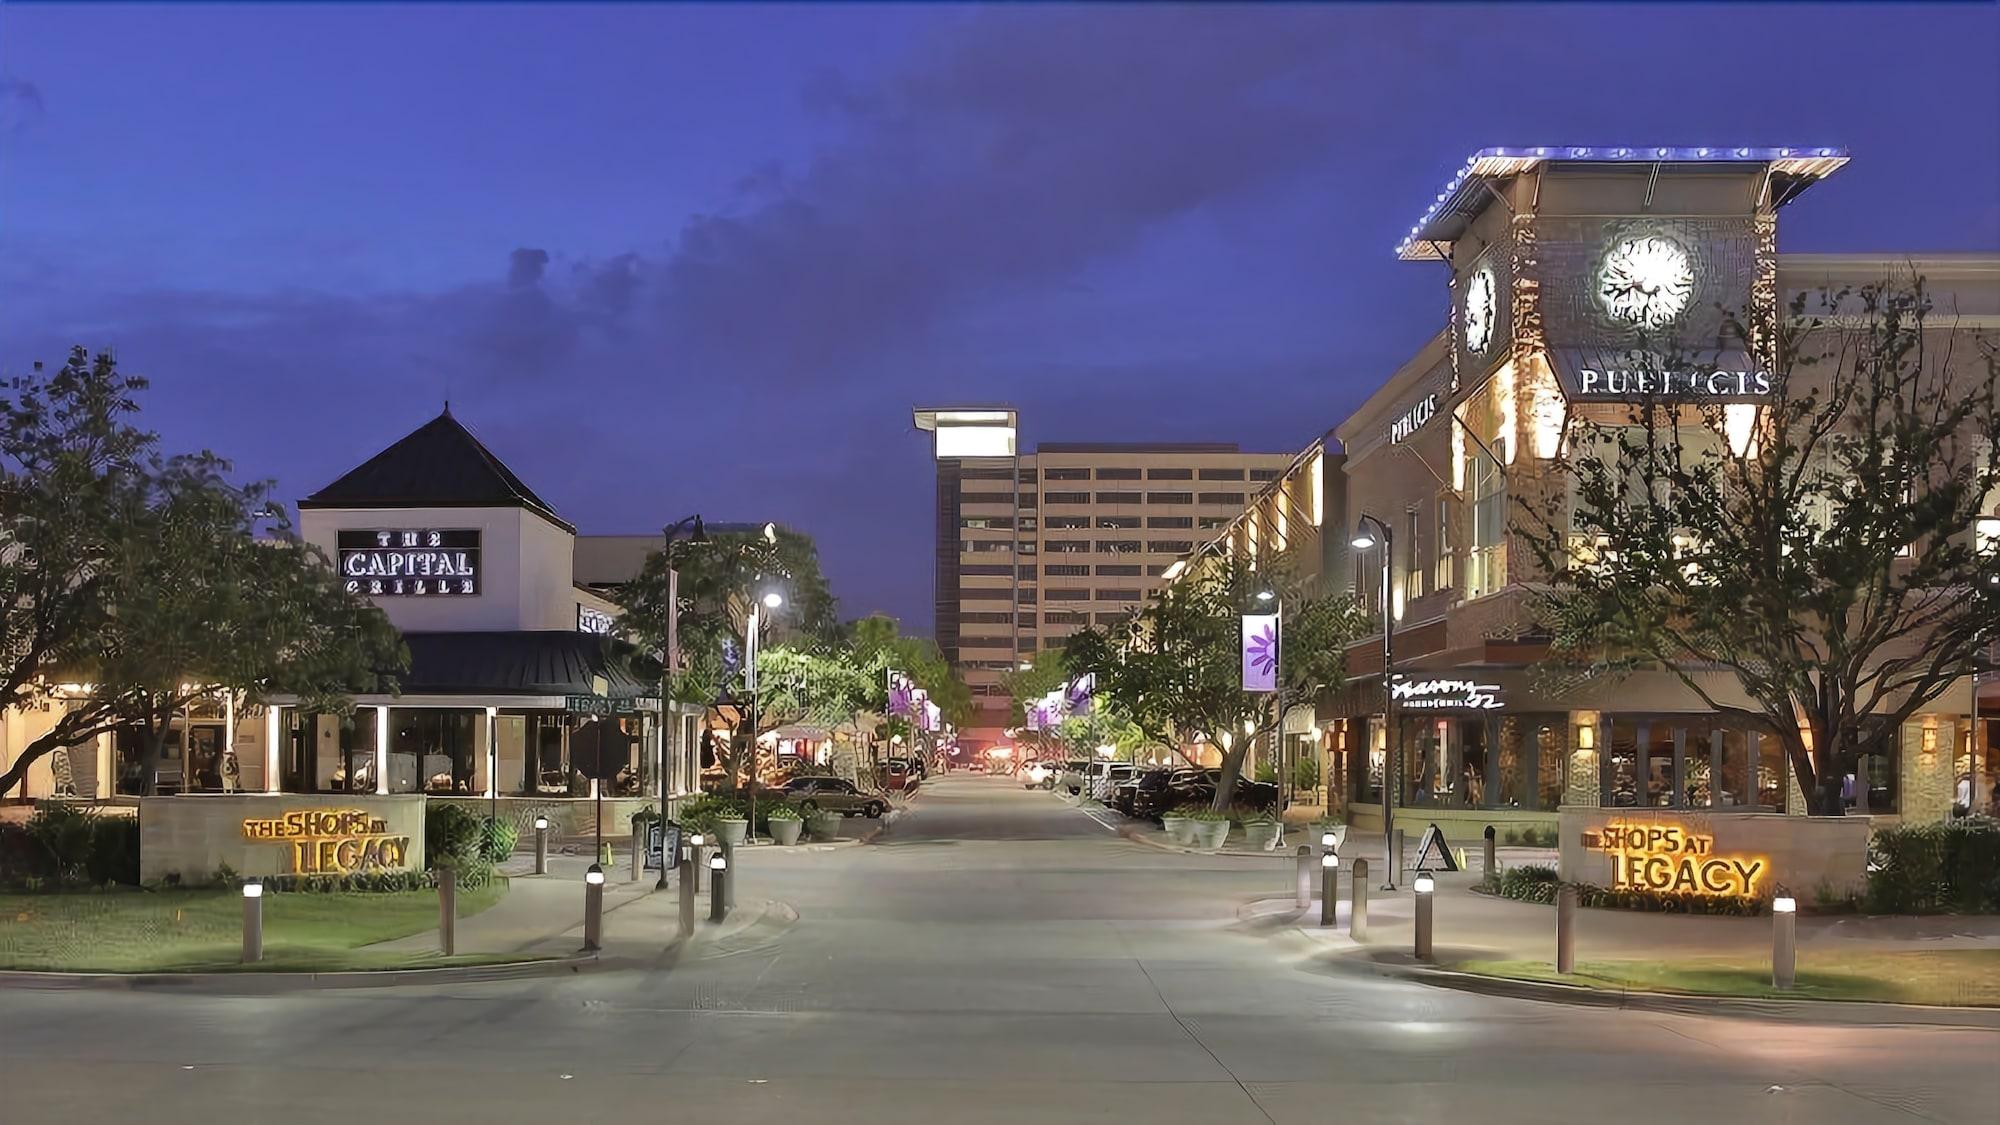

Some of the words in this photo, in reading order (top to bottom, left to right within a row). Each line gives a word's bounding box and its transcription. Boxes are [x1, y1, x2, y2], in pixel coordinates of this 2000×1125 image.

[1391, 393, 1436, 445] PUBLICIS
[376, 531, 441, 547] THE
[343, 552, 474, 576] CAPITAL
[343, 579, 474, 595] GRILLE
[244, 821, 286, 838] THE
[287, 811, 369, 836] SHOPS
[1603, 826, 1680, 853] SHOPS
[1684, 837, 1711, 855] AT
[296, 836, 410, 874] LEGACY
[1610, 854, 1761, 895] LEGACY
